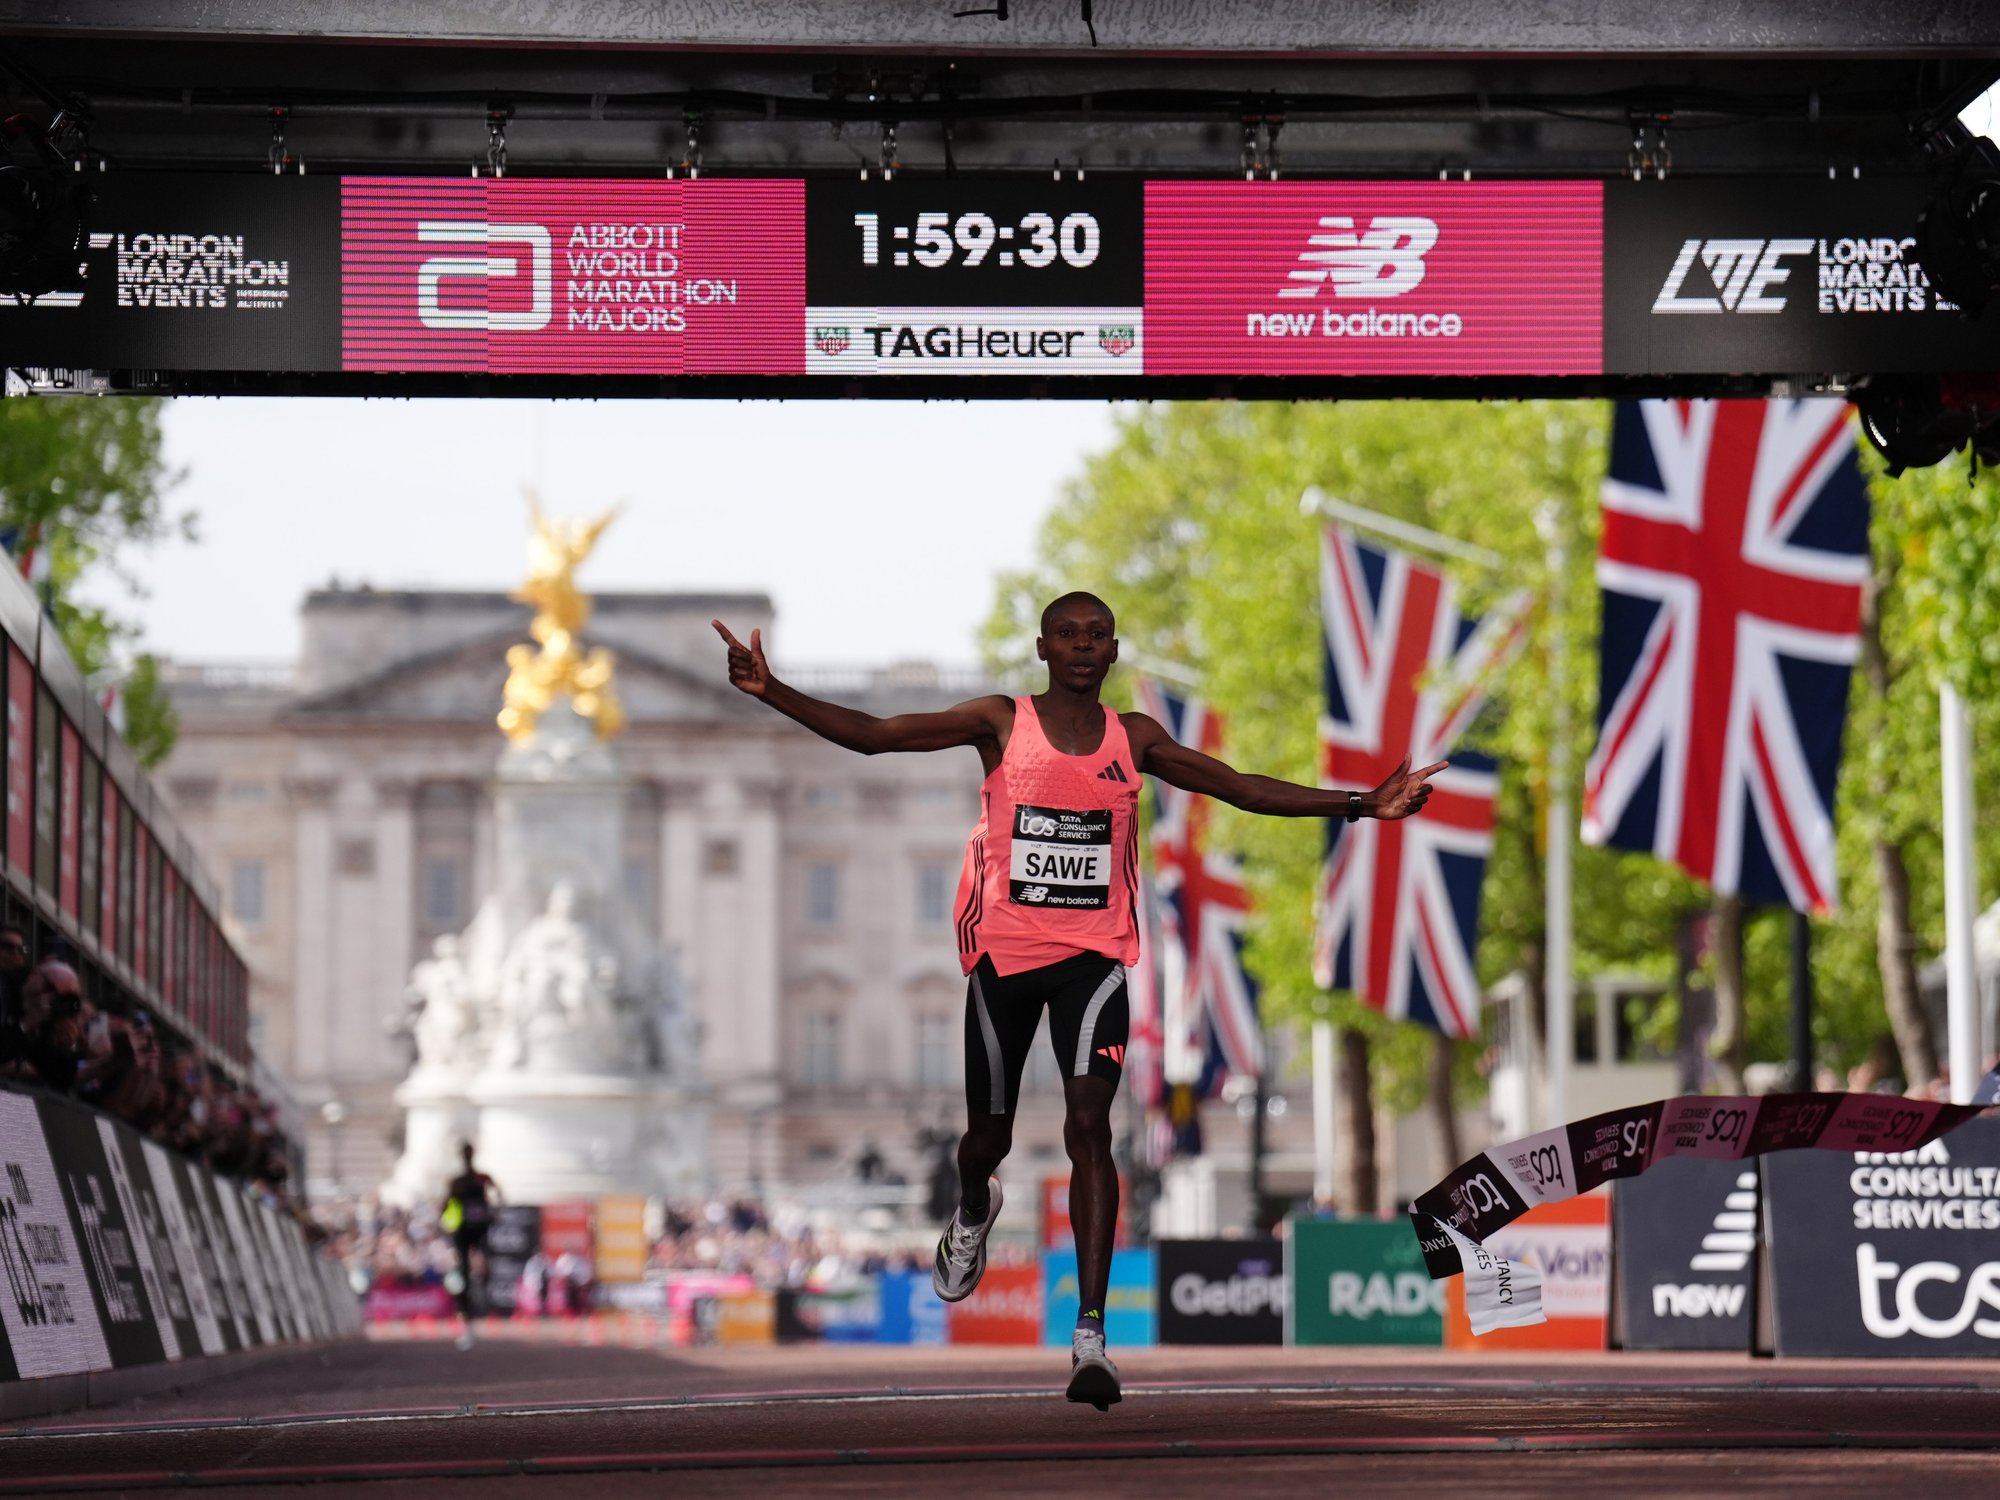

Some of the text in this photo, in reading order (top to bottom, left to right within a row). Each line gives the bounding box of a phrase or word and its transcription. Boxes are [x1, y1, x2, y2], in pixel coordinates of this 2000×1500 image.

[118, 233, 244, 259] LONDON
[567, 222, 684, 249] ABBOTT
[855, 212, 1100, 268] 1:59:30
[118, 260, 289, 285] MARATHON
[567, 251, 679, 277] WORLD
[118, 285, 227, 308] EVENTS
[567, 279, 738, 304] MARATHON
[1819, 288, 1926, 312] EVENTS
[567, 306, 686, 332] MAJORS
[1247, 307, 1463, 337] new balance
[1019, 810, 1060, 837] tcs
[1059, 815, 1082, 823] TATA
[1059, 823, 1106, 832] CONSULTANCY
[1058, 831, 1091, 840] SERVICES
[1025, 852, 1098, 880] SAWE
[1047, 896, 1100, 905] new balance
[1623, 1118, 1653, 1158] cs
[1706, 1109, 1747, 1151] tcs
[1529, 1144, 1565, 1188] tcs
[1849, 1166, 2000, 1198] CONSULT
[1460, 1173, 1510, 1219] tcs
[1853, 1199, 2000, 1230] SERVICES
[1652, 1284, 1747, 1318] new
[1856, 1242, 2000, 1338] tcs
